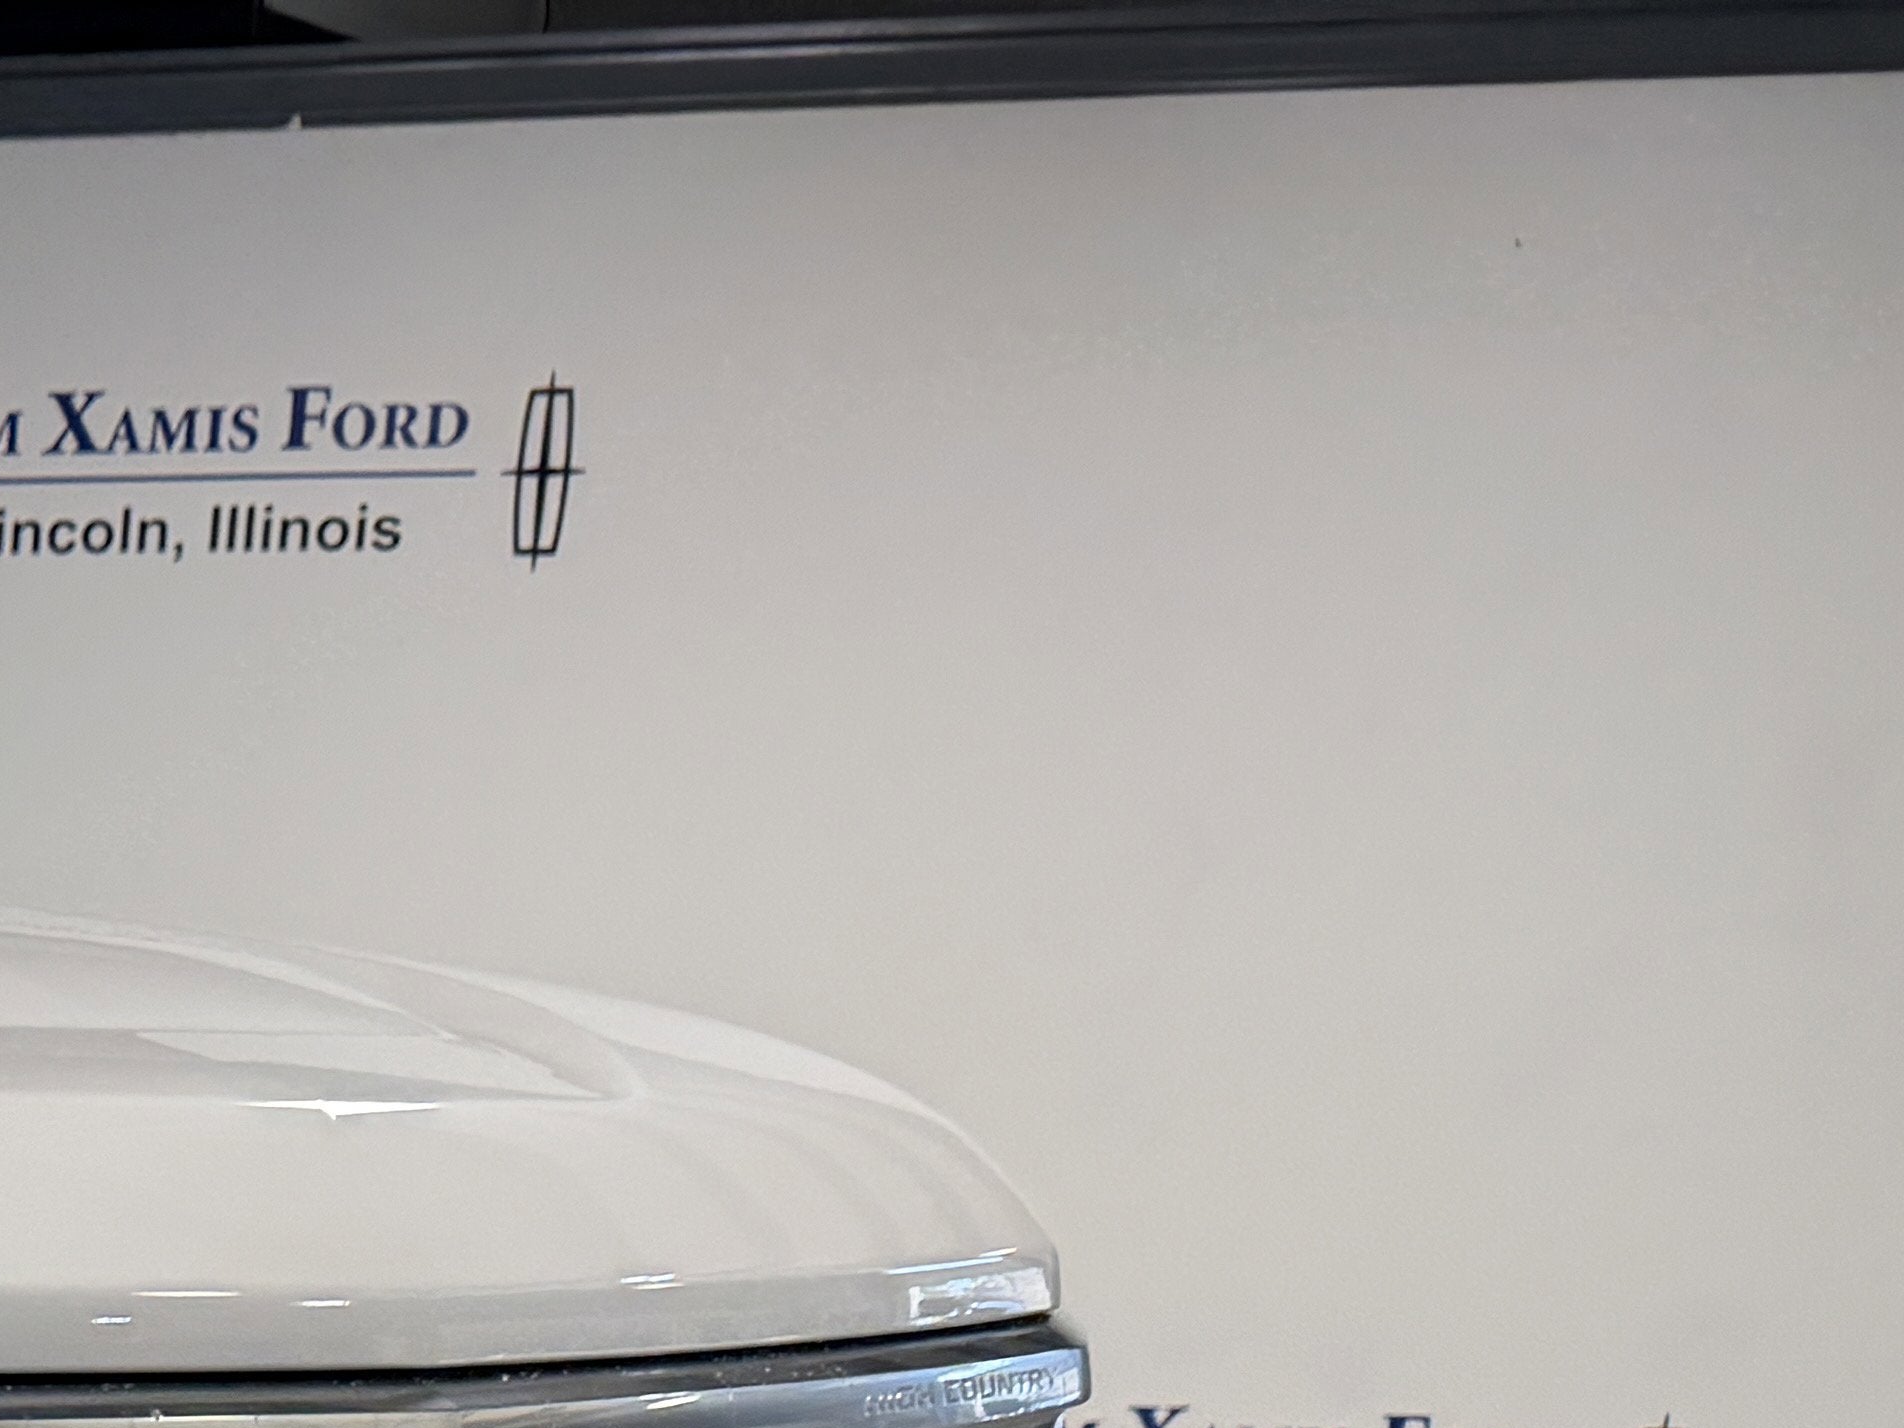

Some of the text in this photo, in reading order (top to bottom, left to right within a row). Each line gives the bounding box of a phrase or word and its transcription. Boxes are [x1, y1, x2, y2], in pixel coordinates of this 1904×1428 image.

[42, 389, 260, 456] XAMIS
[284, 385, 471, 452] FORD
[208, 504, 404, 556] Illinois
[943, 1366, 1060, 1405] COUNTRY
